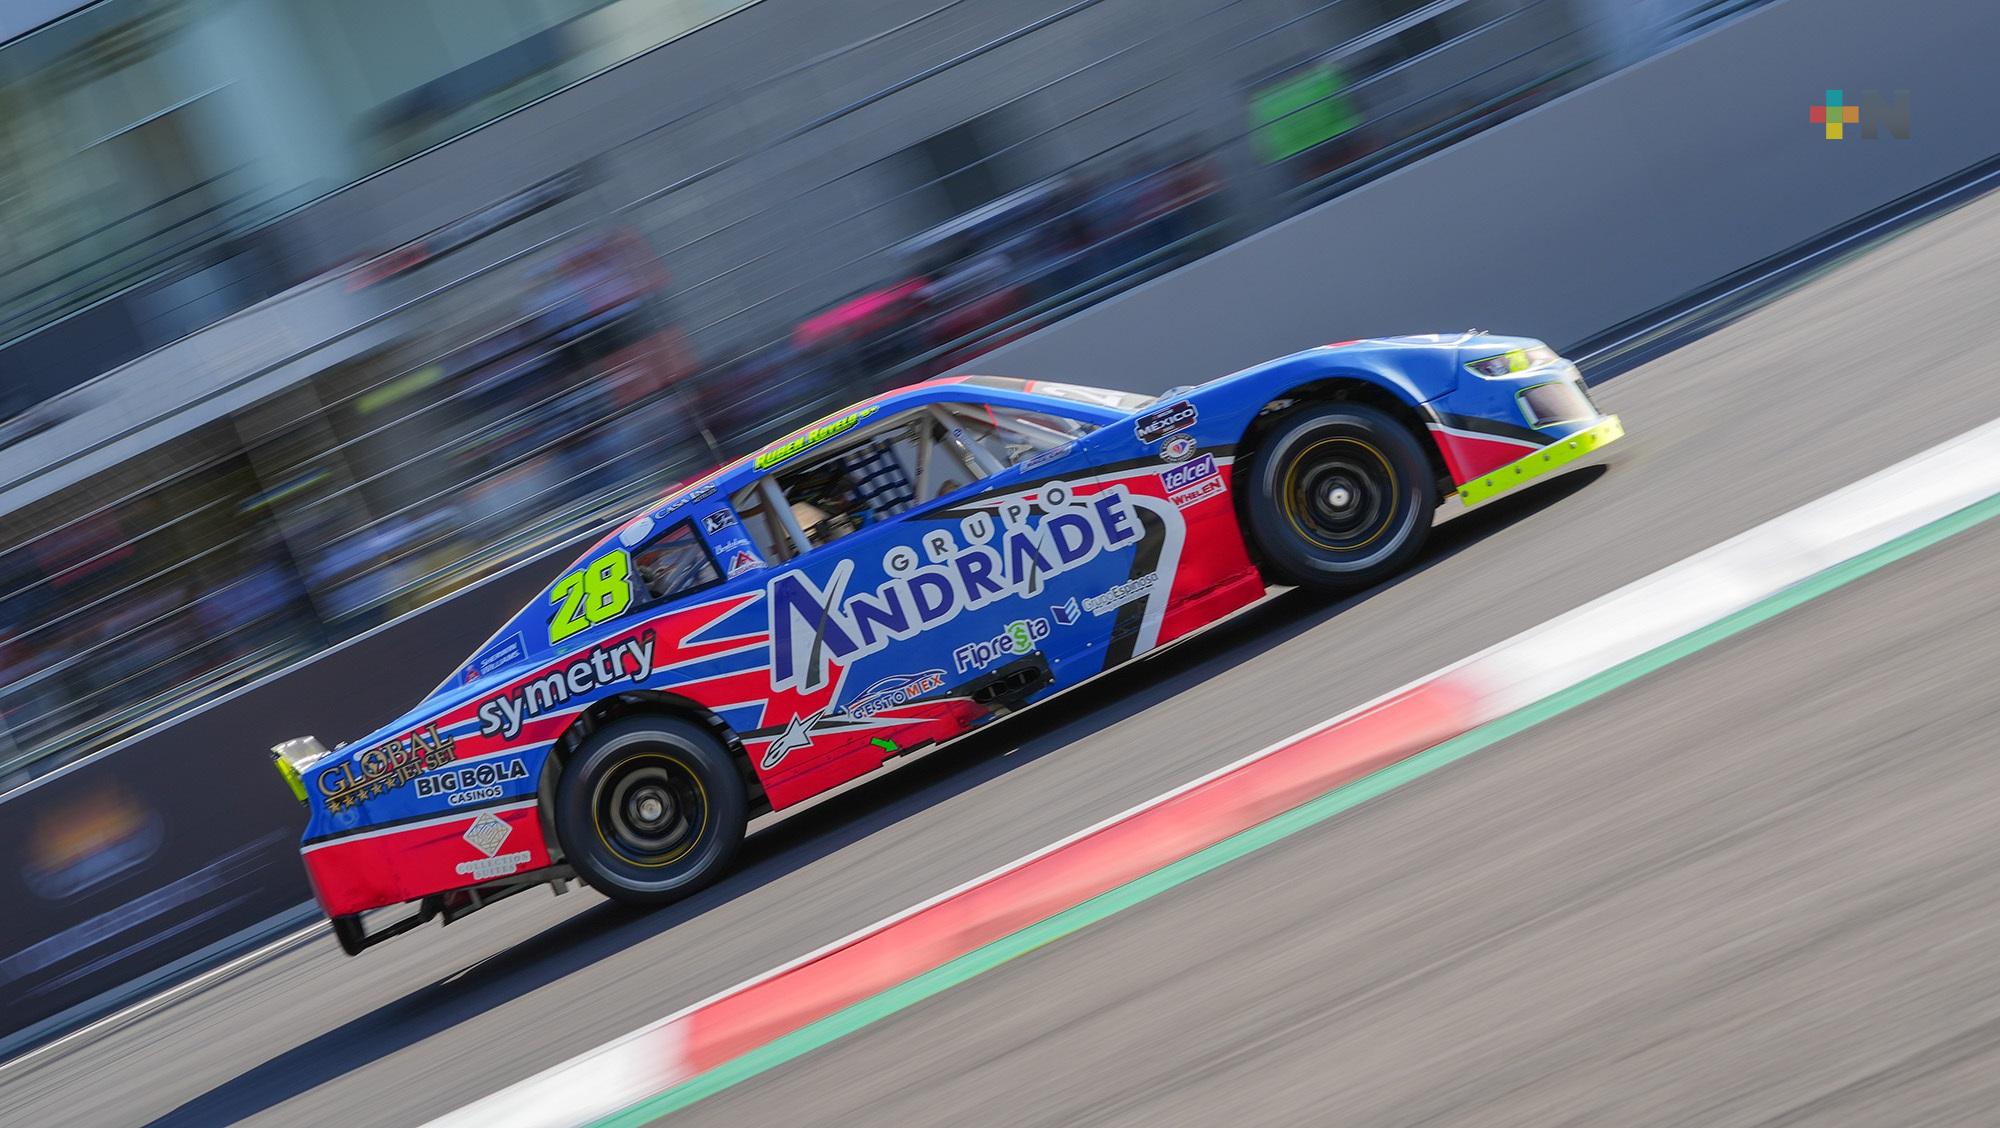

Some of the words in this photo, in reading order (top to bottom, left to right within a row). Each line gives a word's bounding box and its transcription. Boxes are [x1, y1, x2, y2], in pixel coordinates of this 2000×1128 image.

[1138, 408, 1195, 437] MÉXICO
[1165, 457, 1211, 491] telcel
[1171, 480, 1221, 506] WHELEN
[890, 487, 1065, 572] GRUPO
[549, 548, 633, 646] 28
[774, 492, 1135, 690] ANDRADE
[478, 634, 656, 740] symetry
[852, 673, 945, 720] GESTOMEX
[317, 722, 454, 797] GLOBAL
[395, 758, 426, 787] JET
[424, 745, 458, 771] SET
[416, 772, 459, 798] BIG
[459, 759, 529, 789] BOLA
[448, 785, 503, 806] CASINOS
